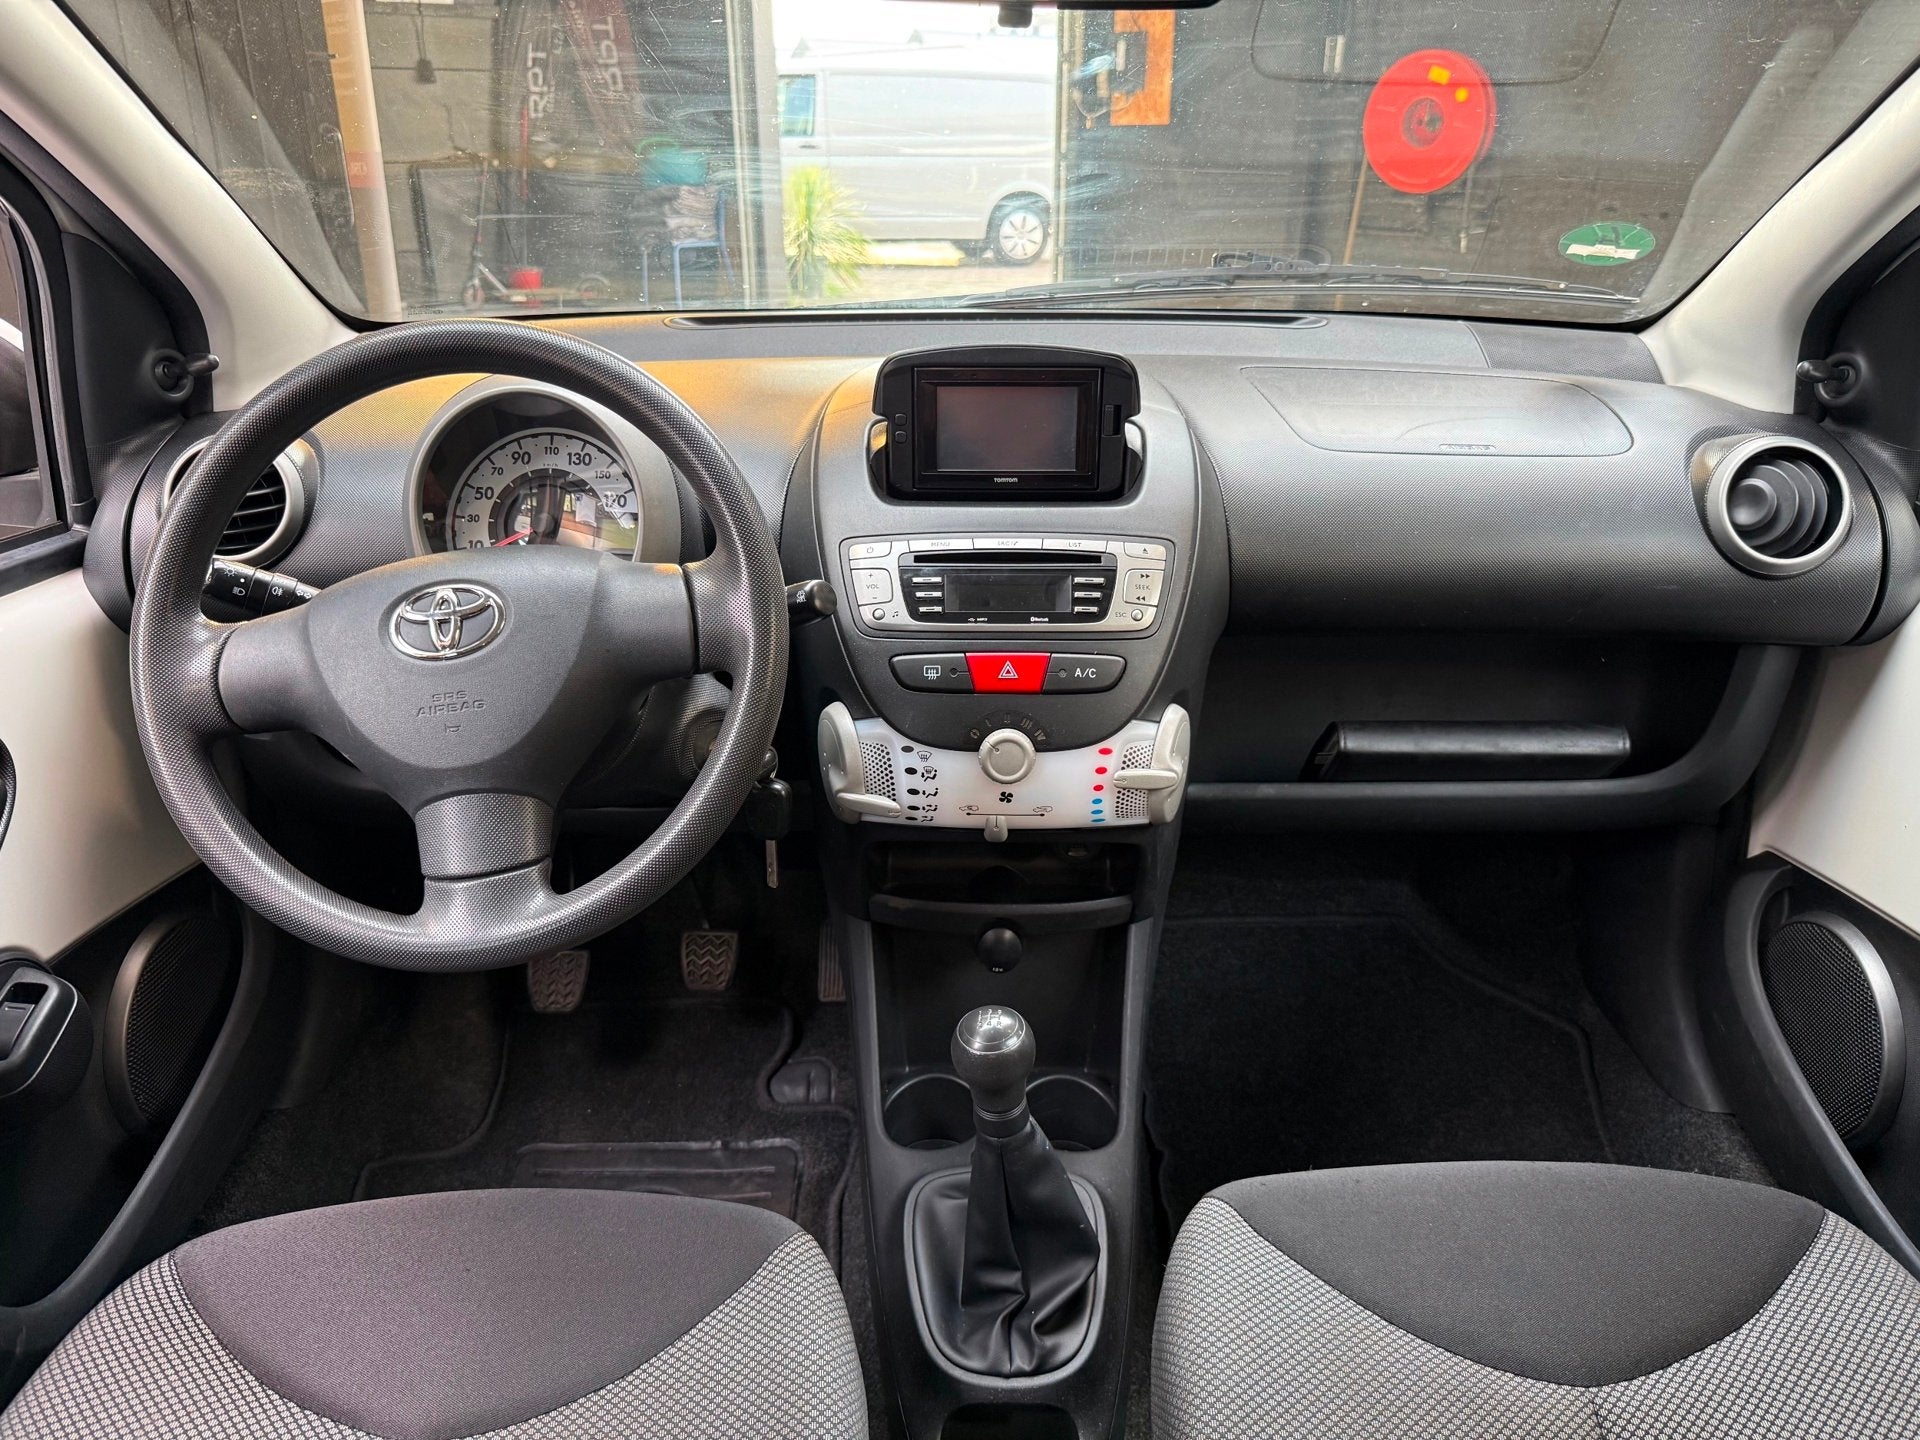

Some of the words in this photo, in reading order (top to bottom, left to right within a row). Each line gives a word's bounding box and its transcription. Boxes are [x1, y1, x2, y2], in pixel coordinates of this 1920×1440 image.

[527, 42, 548, 118] RPT
[544, 446, 559, 455] 110
[511, 451, 531, 466] 90
[567, 452, 592, 466] 130
[491, 466, 503, 475] 70
[594, 470, 611, 480] 150
[474, 486, 494, 500] 50
[467, 514, 480, 523] 30
[468, 539, 484, 548] 10
[1074, 667, 1097, 678] A/C
[432, 690, 467, 702] SRS
[416, 700, 485, 717] AIRBAG
